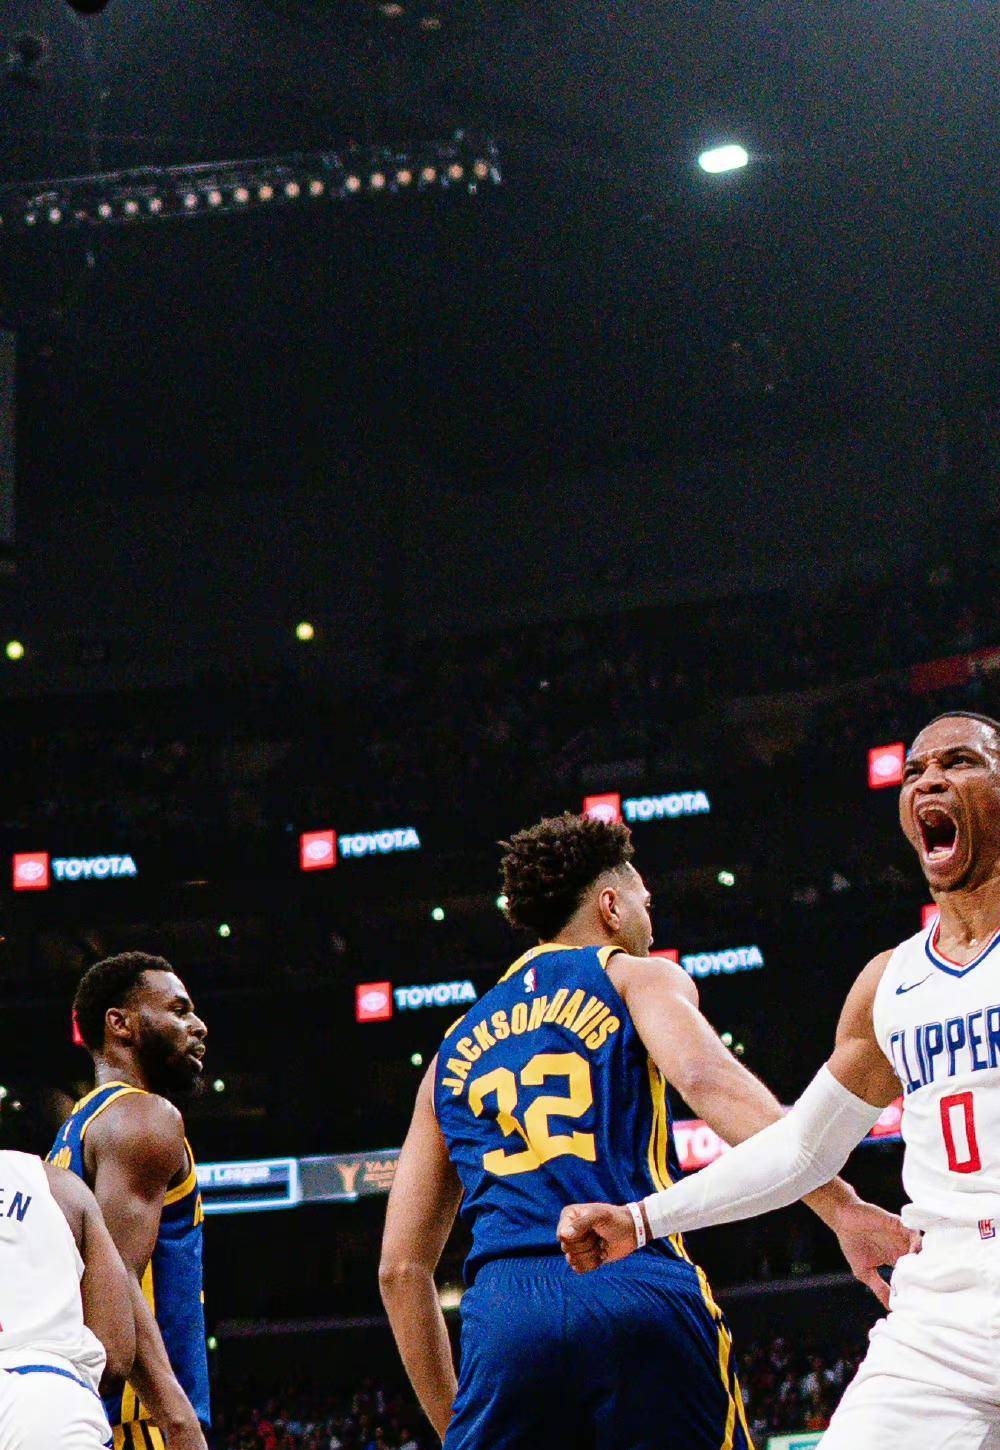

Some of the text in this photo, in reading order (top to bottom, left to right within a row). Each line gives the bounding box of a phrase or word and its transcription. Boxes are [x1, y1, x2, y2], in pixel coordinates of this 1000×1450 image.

[625, 791, 711, 822] TOYOTA
[338, 827, 421, 855] TOYOTA
[53, 852, 137, 879] TOYOTA
[681, 945, 764, 978] TOYOTA
[394, 980, 477, 1009] TOYOTA
[468, 1052, 597, 1176] 32
[940, 1091, 982, 1174] 0
